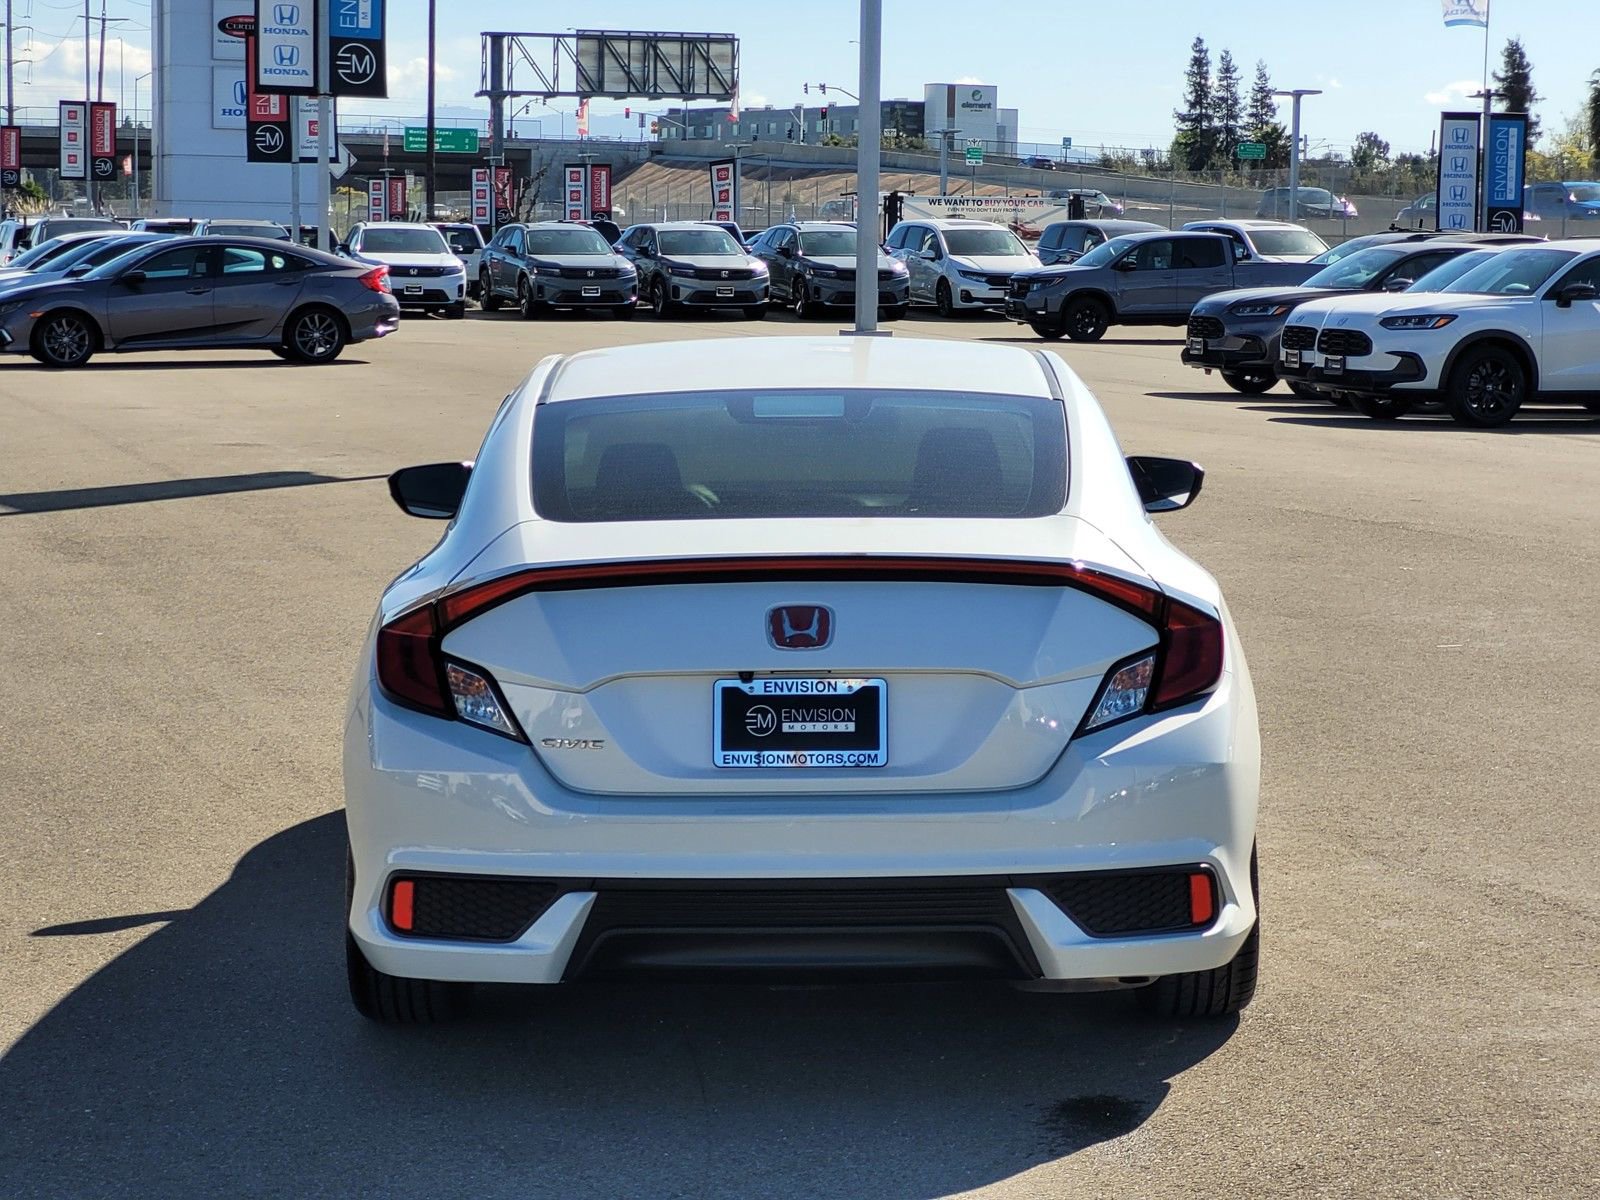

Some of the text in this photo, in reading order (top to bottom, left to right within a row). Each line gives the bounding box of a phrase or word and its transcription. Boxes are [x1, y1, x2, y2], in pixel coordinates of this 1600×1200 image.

[263, 27, 309, 36] HONDA
[263, 68, 309, 76] HONDA
[961, 101, 992, 109] element
[95, 109, 104, 153] ENVISION
[1494, 127, 1509, 200] ENVISION
[928, 198, 1045, 208] WE WANT TO BUY YOUR CAR
[763, 681, 838, 693] ENVISION
[782, 708, 856, 722] ENVISION
[541, 738, 605, 749] CIVIC
[722, 753, 879, 764] ENVISIONMOTORS.COM
